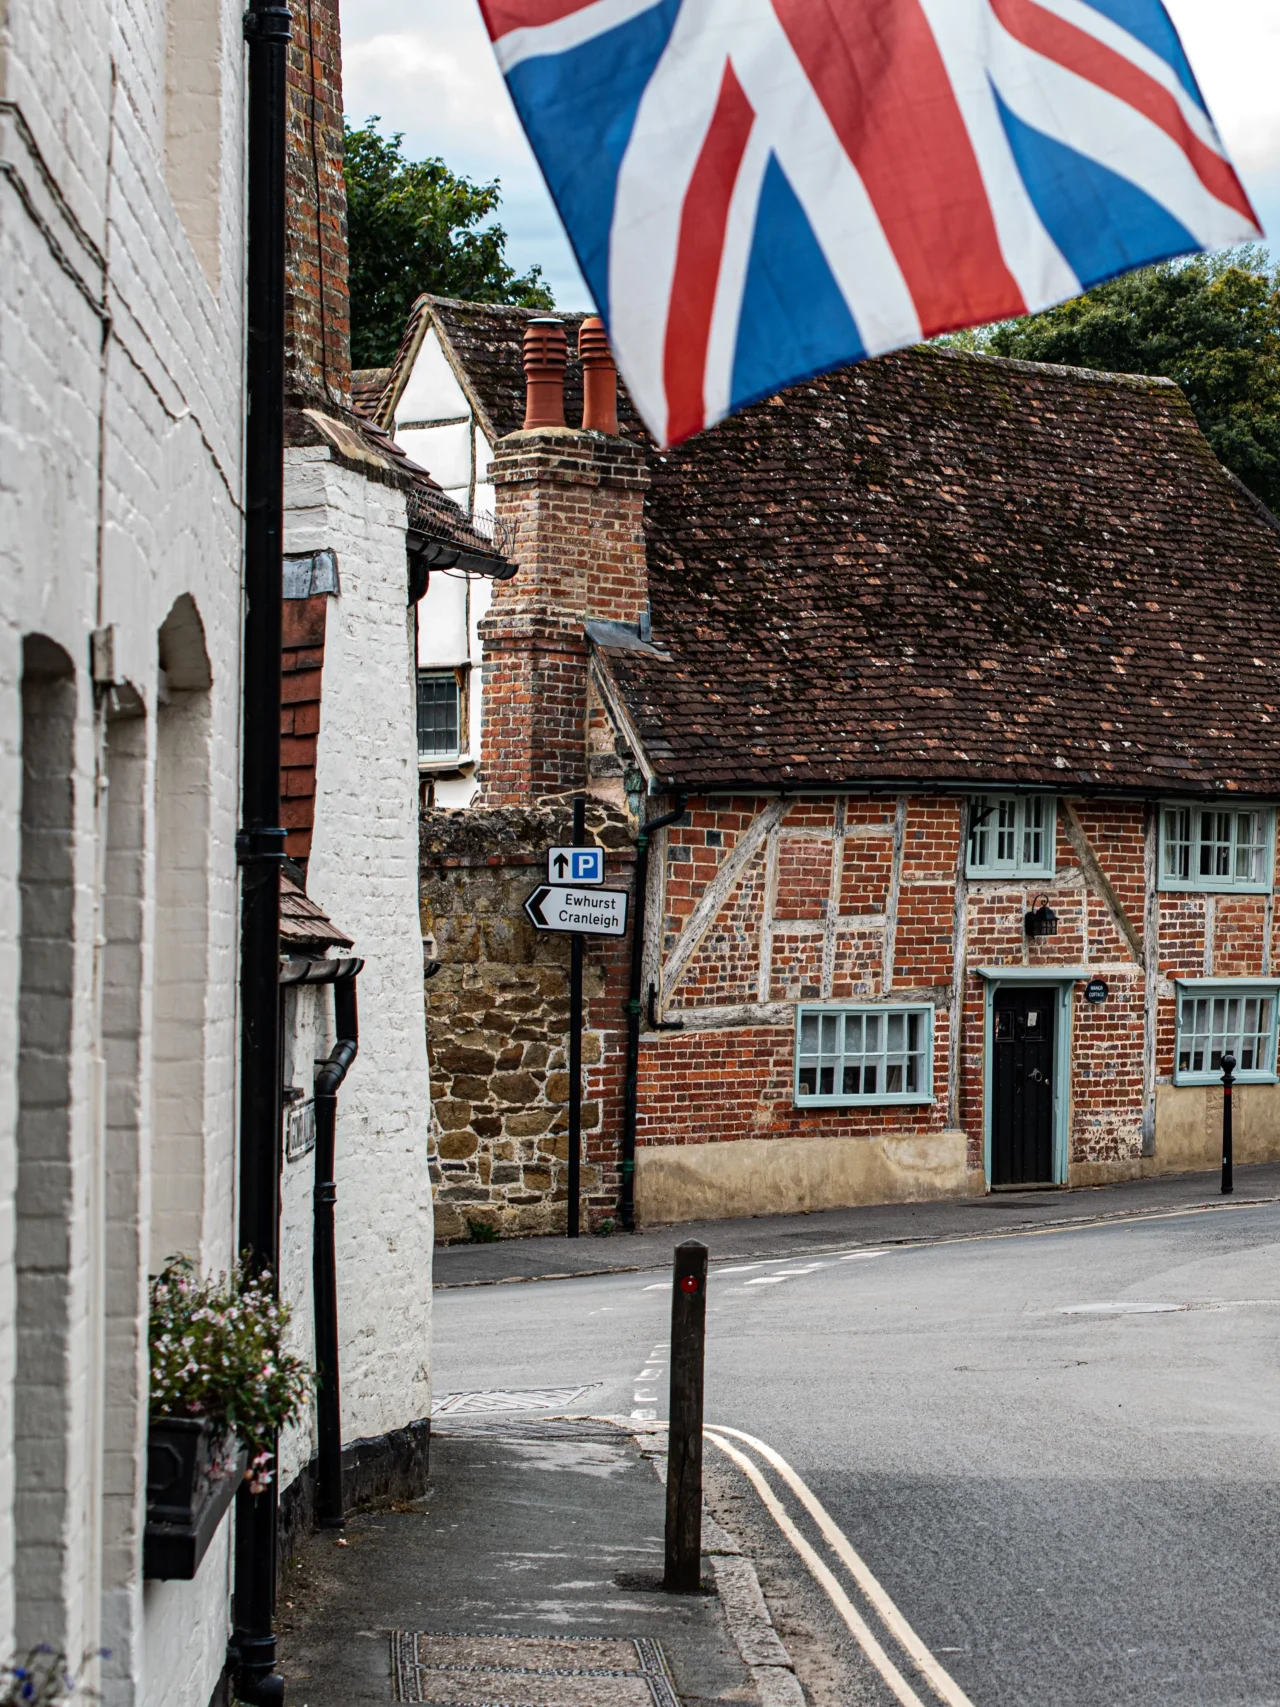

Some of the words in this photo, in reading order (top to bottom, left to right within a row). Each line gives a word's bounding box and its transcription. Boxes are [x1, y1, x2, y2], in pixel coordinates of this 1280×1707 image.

[578, 855, 595, 877] P
[565, 893, 616, 910] Ewhurst
[558, 909, 619, 929] Cranleigh
